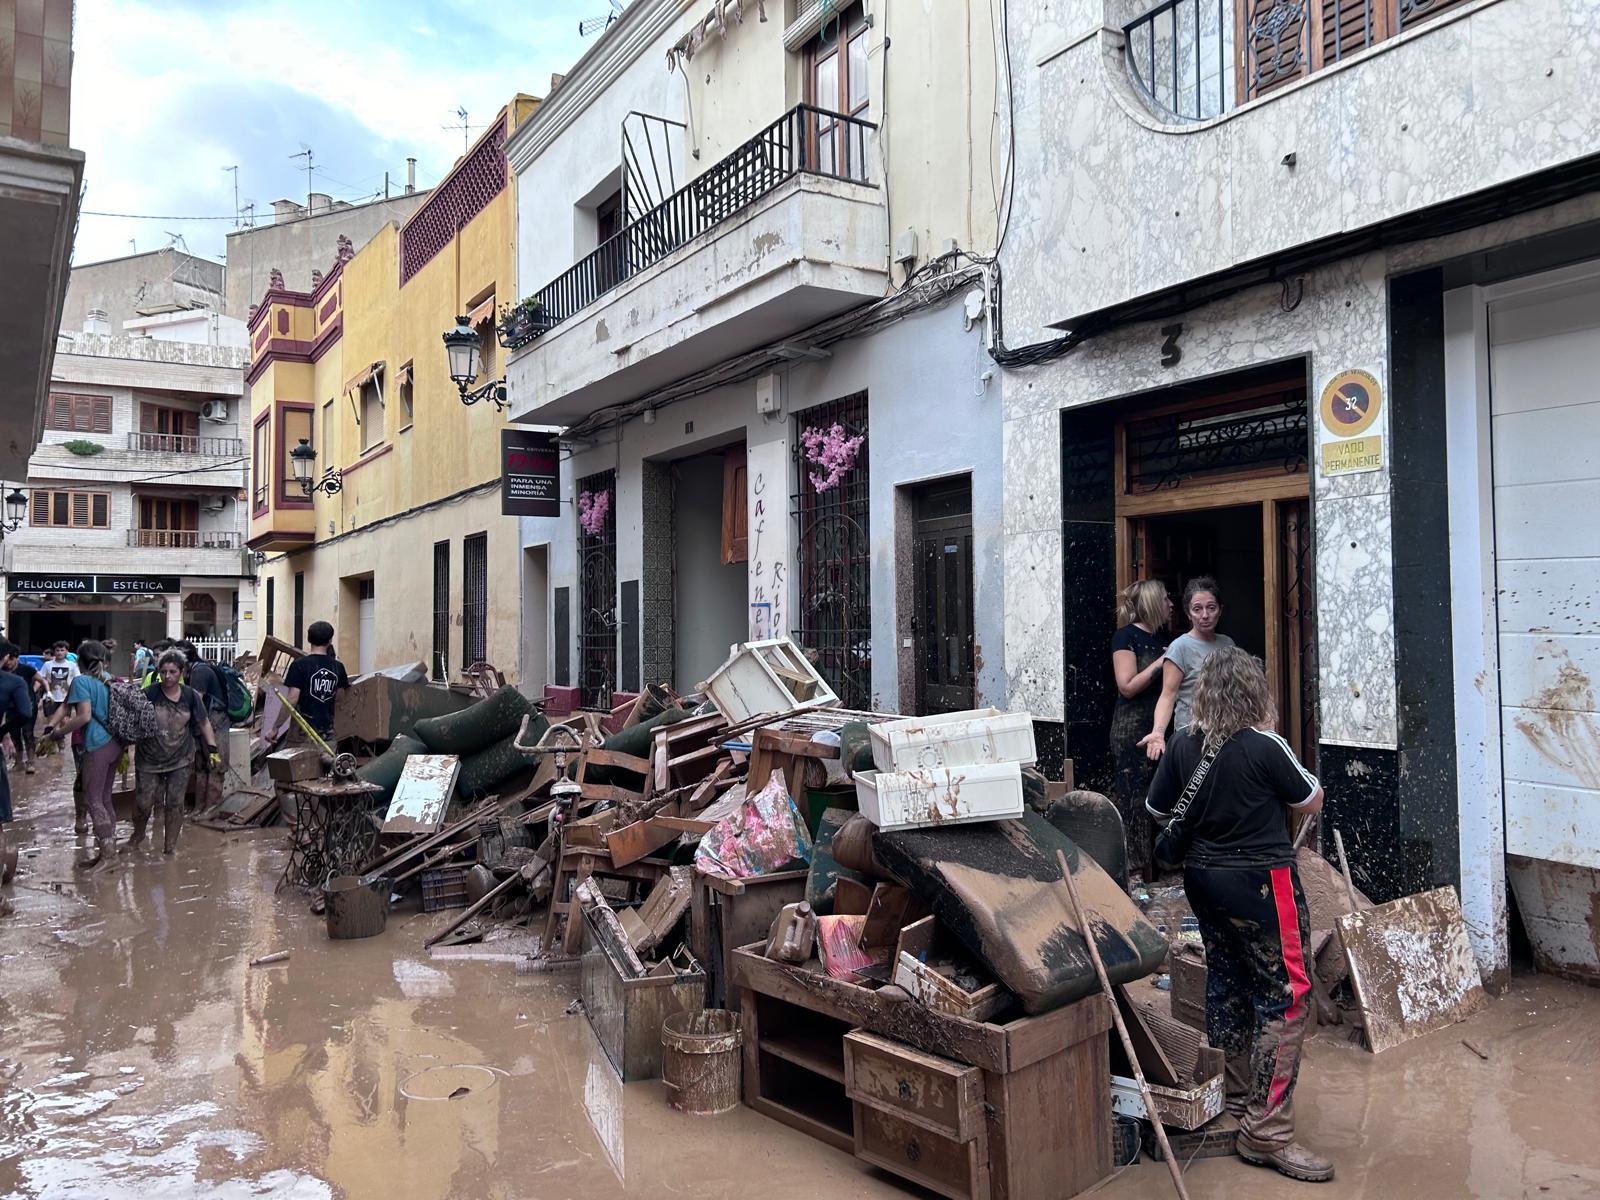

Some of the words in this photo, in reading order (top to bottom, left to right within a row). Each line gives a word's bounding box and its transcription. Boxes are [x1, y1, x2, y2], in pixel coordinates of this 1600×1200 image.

[1161, 323, 1183, 368] 3
[1345, 396, 1358, 410] 32
[1338, 441, 1364, 455] VADO
[1325, 454, 1380, 472] PERMANENTE
[17, 579, 85, 589] PELUQUERÍA
[113, 580, 164, 590] ESTÉTICA
